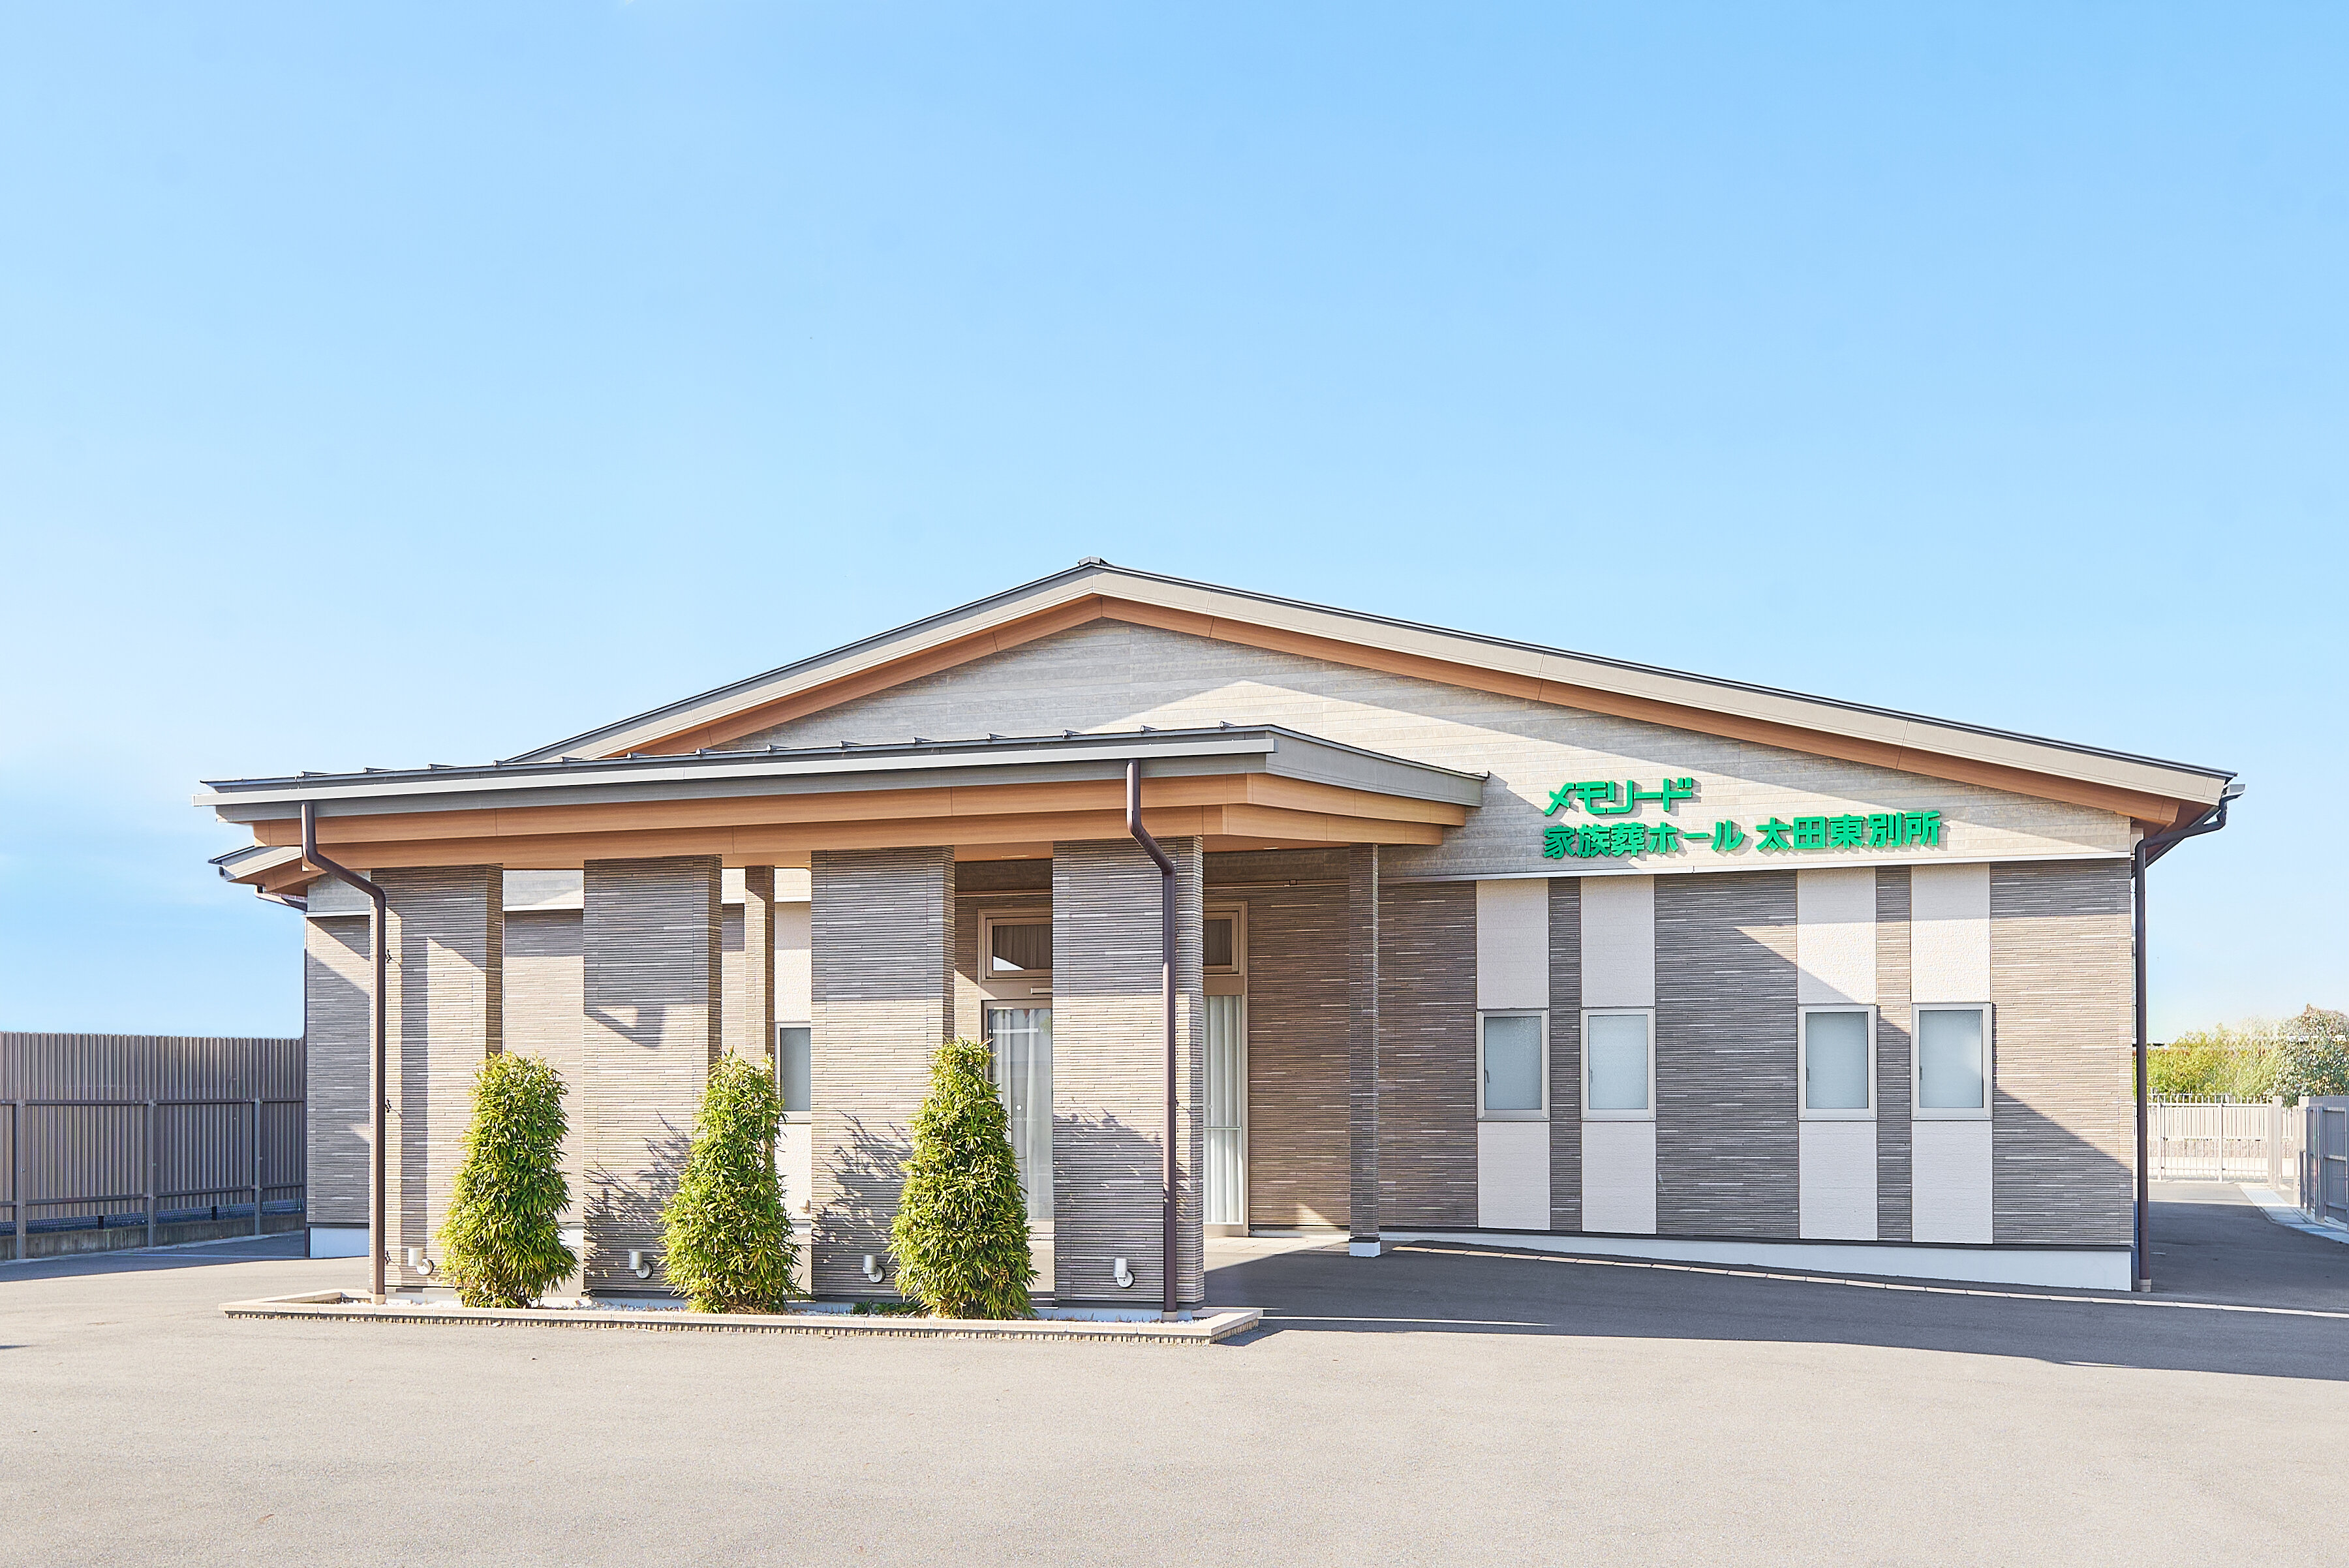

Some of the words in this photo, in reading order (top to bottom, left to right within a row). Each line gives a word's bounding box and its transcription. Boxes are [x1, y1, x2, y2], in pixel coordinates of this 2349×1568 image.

[1544, 777, 1693, 816] メモリード
[1543, 820, 1745, 859] 家族葬ホール
[1756, 810, 1941, 852] 太田東別所
